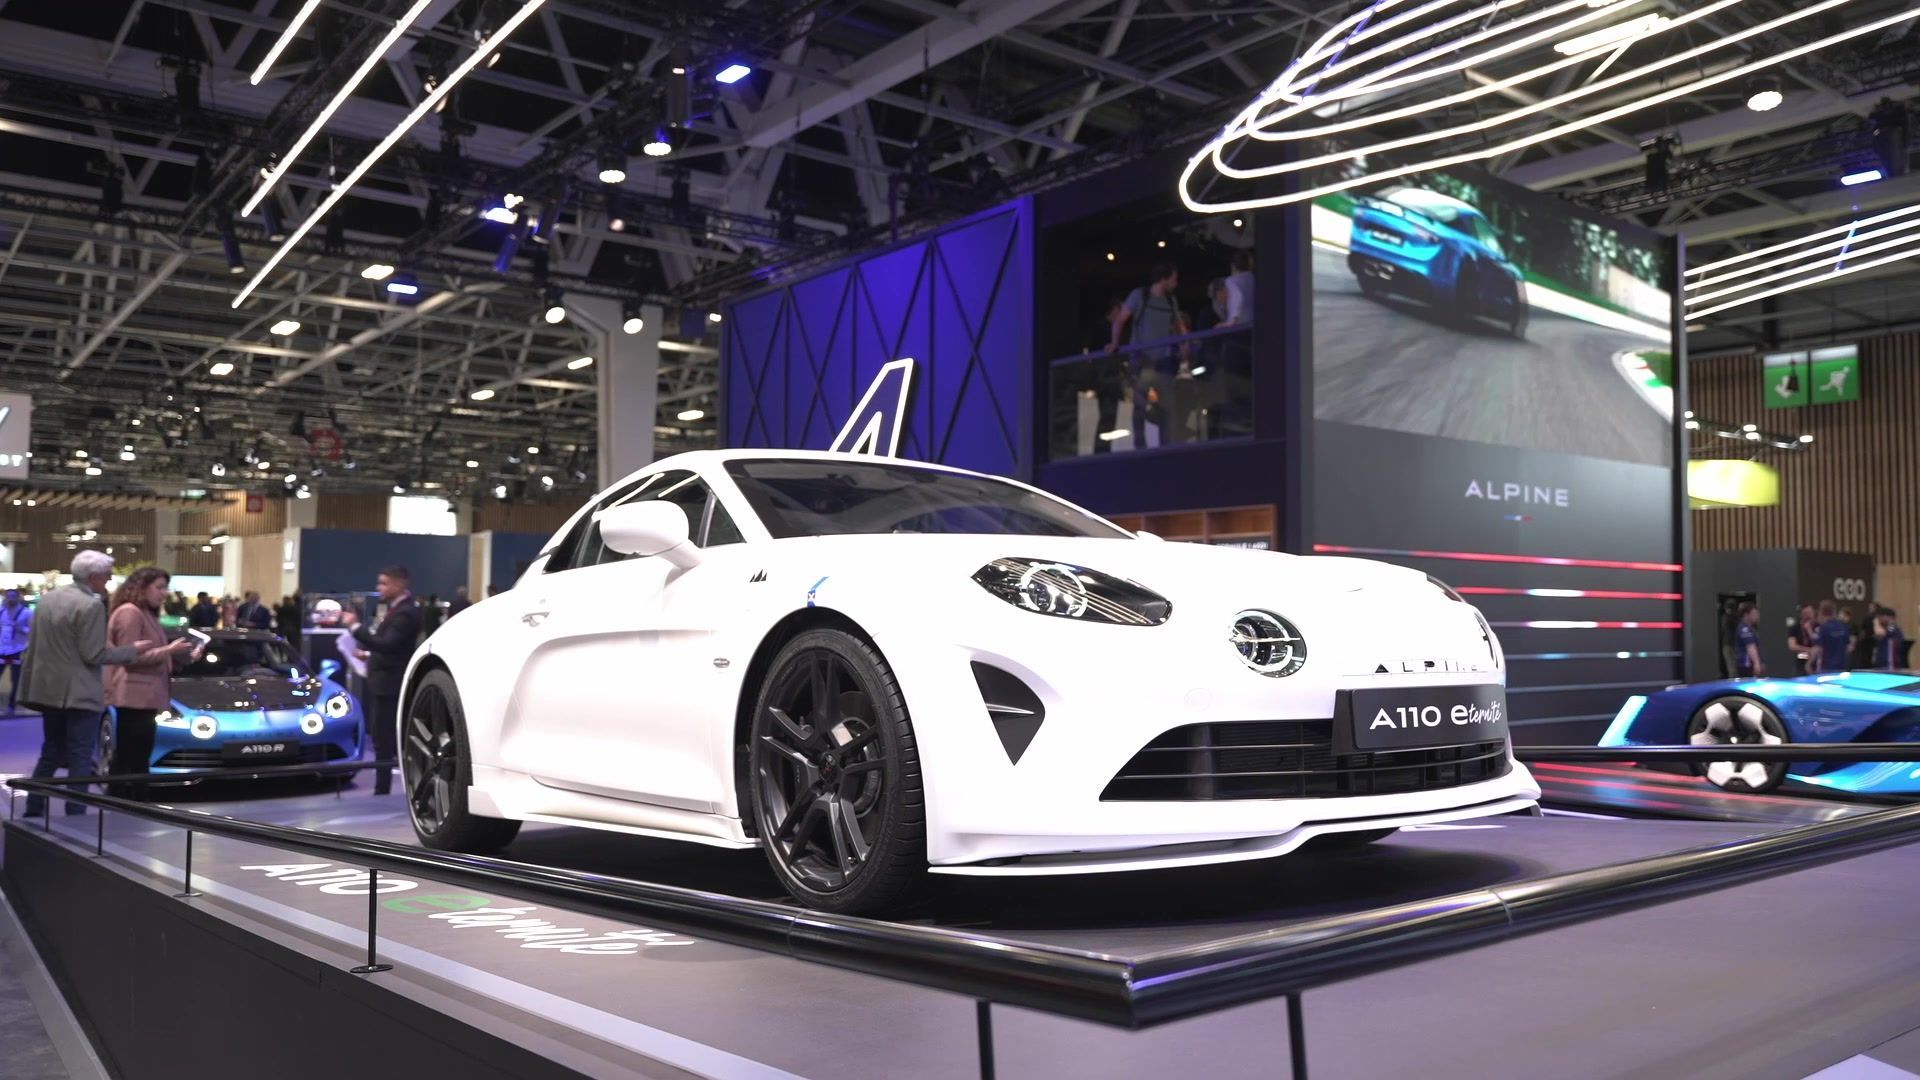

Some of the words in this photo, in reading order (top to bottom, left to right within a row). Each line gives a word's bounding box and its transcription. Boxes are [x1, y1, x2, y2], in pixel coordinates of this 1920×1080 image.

[1464, 479, 1569, 508] ALPINE
[1369, 705, 1442, 730] A110
[240, 745, 272, 754] A110
[239, 863, 419, 895] A110
